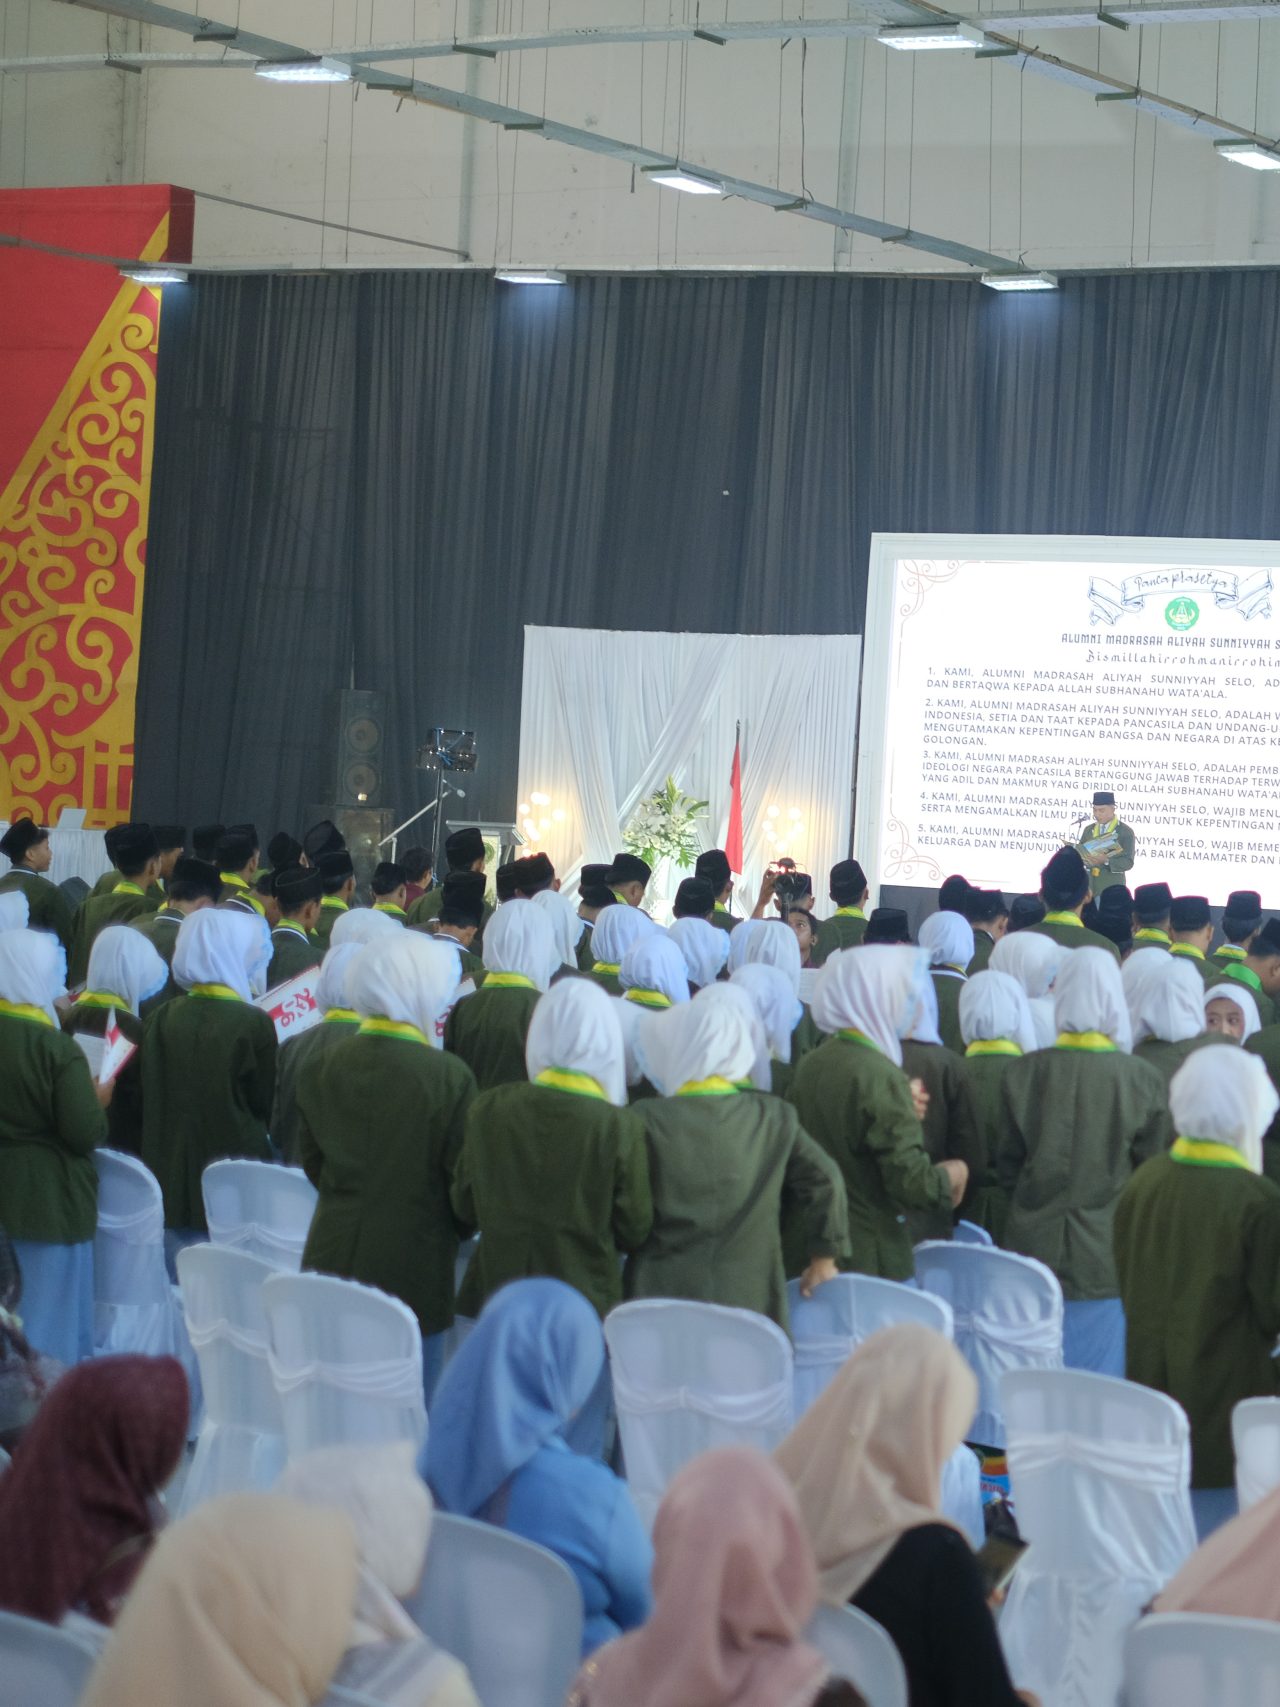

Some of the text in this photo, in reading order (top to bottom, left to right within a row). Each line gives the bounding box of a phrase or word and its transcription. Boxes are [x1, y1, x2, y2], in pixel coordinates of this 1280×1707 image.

[1061, 633, 1101, 644] ALUMNI
[1105, 634, 1162, 645] MADRASAH
[1167, 636, 1205, 647] ALIYAH
[1210, 637, 1270, 648] SUNNIYYAH
[926, 679, 948, 688] DAN
[952, 680, 1009, 691] BERTAQWA
[1013, 682, 1054, 691] KEPADA
[1057, 684, 1092, 693] ALLAH
[1095, 685, 1164, 696] SUBHANAHU
[928, 666, 935, 674] 1.
[944, 667, 973, 676] KAMI,
[982, 668, 1024, 678] ALUMNI
[1033, 670, 1093, 680] MADRASAH
[1102, 673, 1141, 682] ALIYAH
[1150, 674, 1215, 684] SUNNIYYAH
[1224, 677, 1254, 687] SELO,
[924, 710, 984, 721] INDONESIA,
[988, 713, 1017, 722] SETIA
[1020, 714, 1043, 723] DAN
[1047, 715, 1074, 724] TAAT
[1077, 716, 1120, 726] KEPADA
[1123, 718, 1184, 729] PANCASILA
[1188, 721, 1212, 730] DAN
[925, 698, 933, 706] 2.
[937, 698, 966, 708] KAMI,
[969, 700, 1012, 709] ALUMNI
[1016, 702, 1076, 712] MADRASAH
[1079, 704, 1119, 713] ALIYAH
[1122, 706, 1187, 716] SUNNIYYAH
[1191, 708, 1221, 719] SELO,
[1224, 710, 1270, 720] ADALAH
[923, 734, 986, 745] GOLONGAN.
[924, 722, 1015, 734] MENGUTAMAKAN
[1018, 726, 1095, 737] KEPENTINGAN
[1098, 730, 1143, 740] BANGSA
[1146, 732, 1170, 741] DAN
[1174, 733, 1220, 743] NEGARA
[1223, 735, 1234, 744] DI
[1238, 736, 1266, 745] ATAS
[923, 750, 930, 758] 3.
[934, 751, 961, 760] KAMI,
[964, 752, 1004, 761] ALUMNI
[1008, 754, 1064, 764] MADRASAH
[1067, 757, 1104, 766] ALIYAH
[1107, 758, 1168, 769] SUNNIYYAH
[1171, 761, 1199, 771] SELO,
[1202, 763, 1246, 772] ADALAH
[922, 762, 969, 771] IDEOLOGI
[972, 764, 1012, 774] NEGARA
[1015, 766, 1071, 776] PANCASILA
[1074, 769, 1152, 780] BERTANGGUNG
[1154, 773, 1189, 782] JAWAB
[1193, 774, 1248, 785] TERHADAP
[922, 773, 948, 782] YANG
[951, 775, 974, 784] ADIL
[977, 776, 998, 784] DAN
[1002, 777, 1047, 787] MAKMUR
[1050, 780, 1078, 789] YANG
[1082, 781, 1127, 791] DIRIDLOI
[1130, 784, 1164, 793] ALLAH
[1167, 785, 1234, 796] SUBHANAHU
[931, 792, 960, 802] KAMI,
[963, 793, 1005, 803] ALUMNI
[1008, 796, 1067, 806] MADRASAH
[1114, 801, 1176, 812] SUNNIYYAH
[1179, 804, 1209, 815] SELO,
[1212, 806, 1245, 817] WAJIB
[921, 803, 951, 812] SERTA
[954, 805, 1037, 817] MENGAMALKAN
[1040, 809, 1067, 819] ILMU
[1154, 816, 1192, 825] UNTUK
[1196, 818, 1273, 829] KEPENTINGAN
[917, 823, 926, 832] 5.
[929, 824, 958, 834] KAMI,
[961, 826, 1003, 836] ALUMNI
[1007, 829, 1066, 839] MADRASAH
[1178, 838, 1207, 849] SELO,
[1210, 840, 1243, 851] WAJIB
[917, 835, 971, 846] KELUARGA
[974, 838, 996, 848] DAN
[1000, 840, 1062, 853] MENJUNJUN
[1150, 849, 1175, 859] BAIK
[1178, 851, 1247, 862] ALMAMATER
[1250, 854, 1274, 864] DAN
